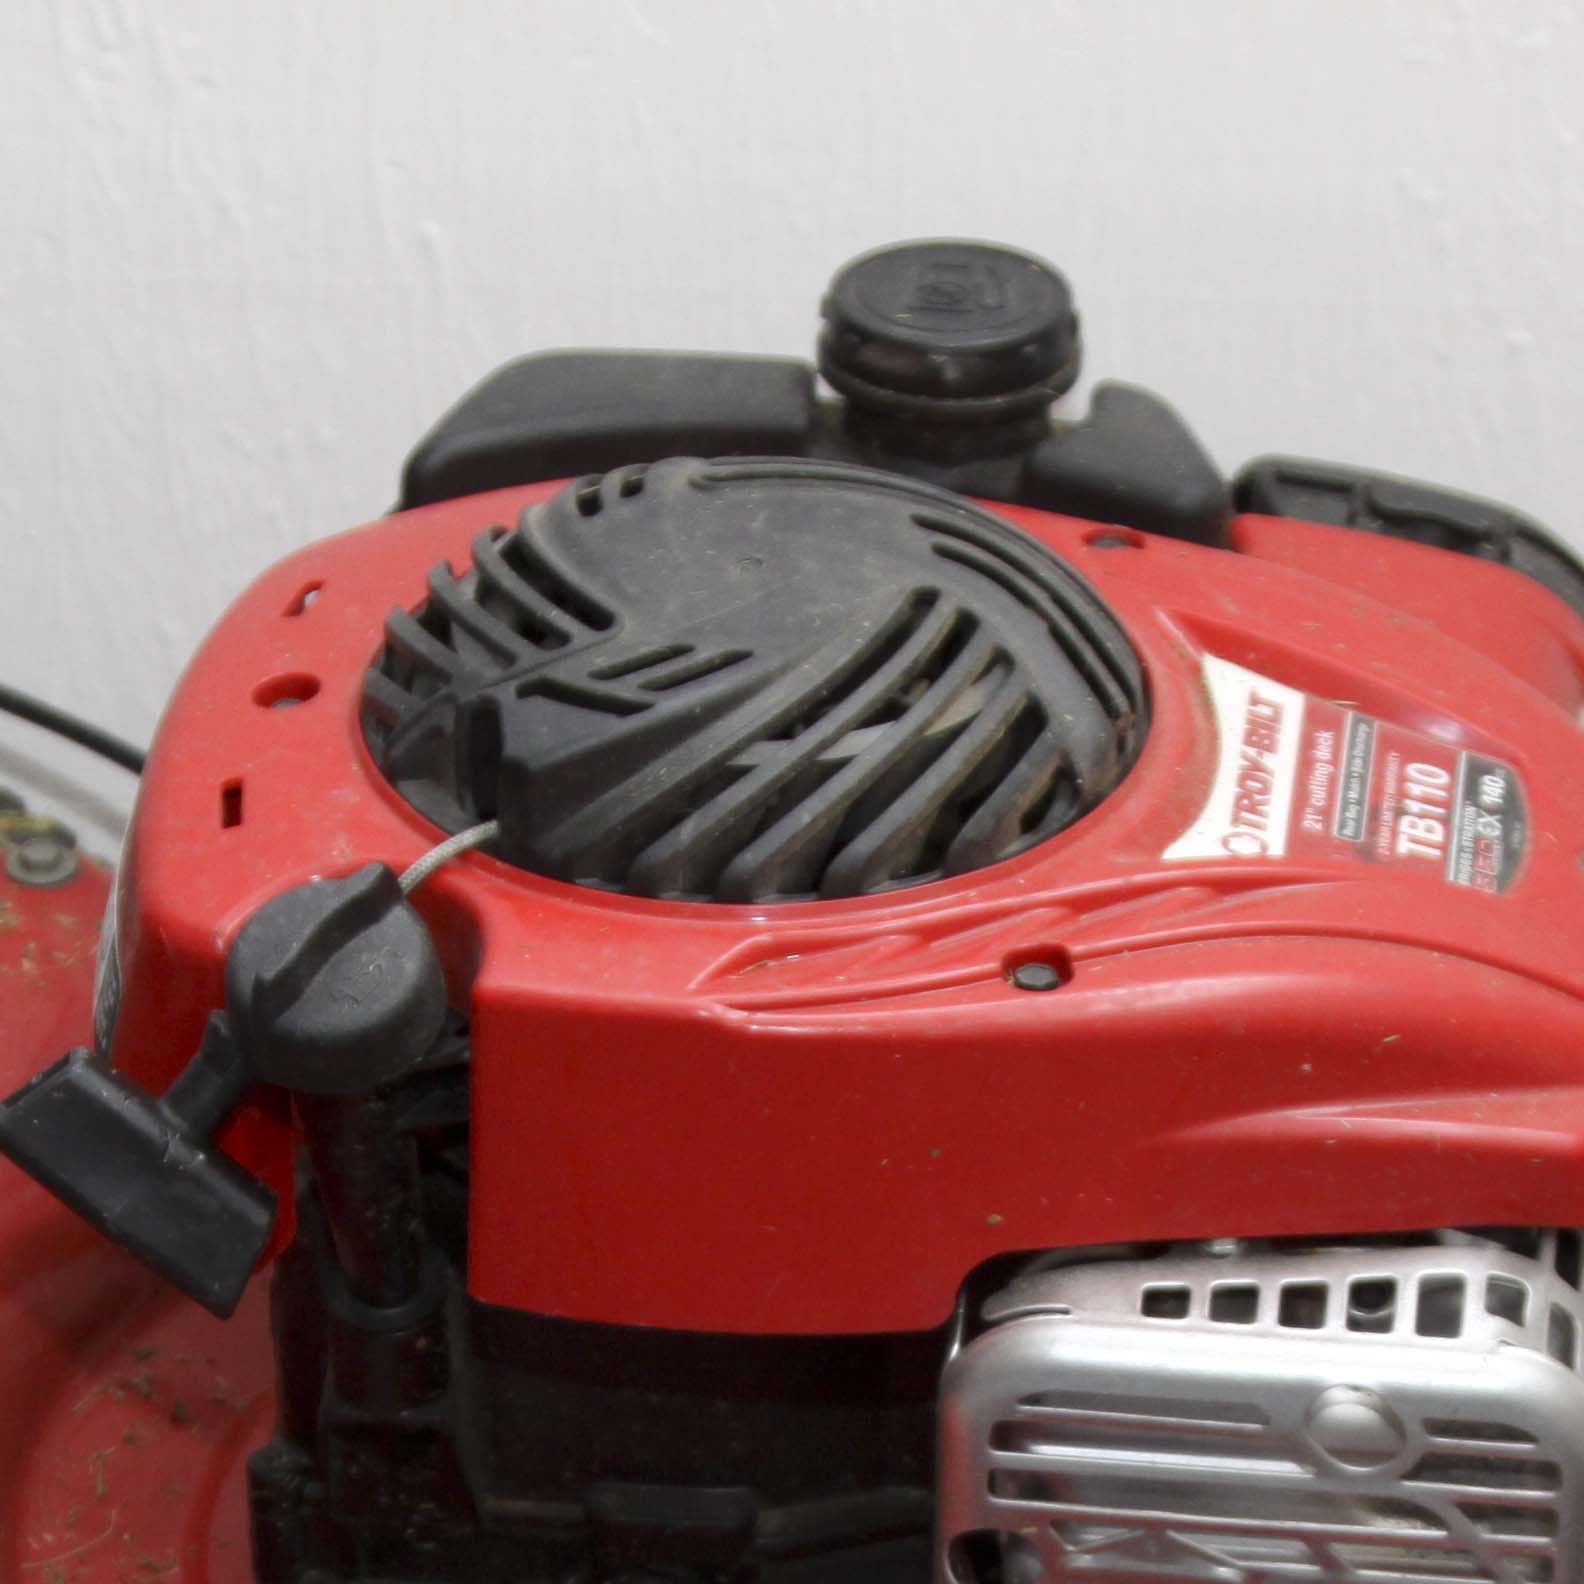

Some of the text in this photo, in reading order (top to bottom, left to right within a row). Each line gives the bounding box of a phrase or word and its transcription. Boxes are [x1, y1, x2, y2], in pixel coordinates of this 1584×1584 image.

[1230, 685, 1284, 832] TROY-BILT
[1311, 729, 1335, 760] deck
[1307, 762, 1335, 806] cutting
[1479, 775, 1506, 804] 140
[1396, 762, 1450, 858] TB110
